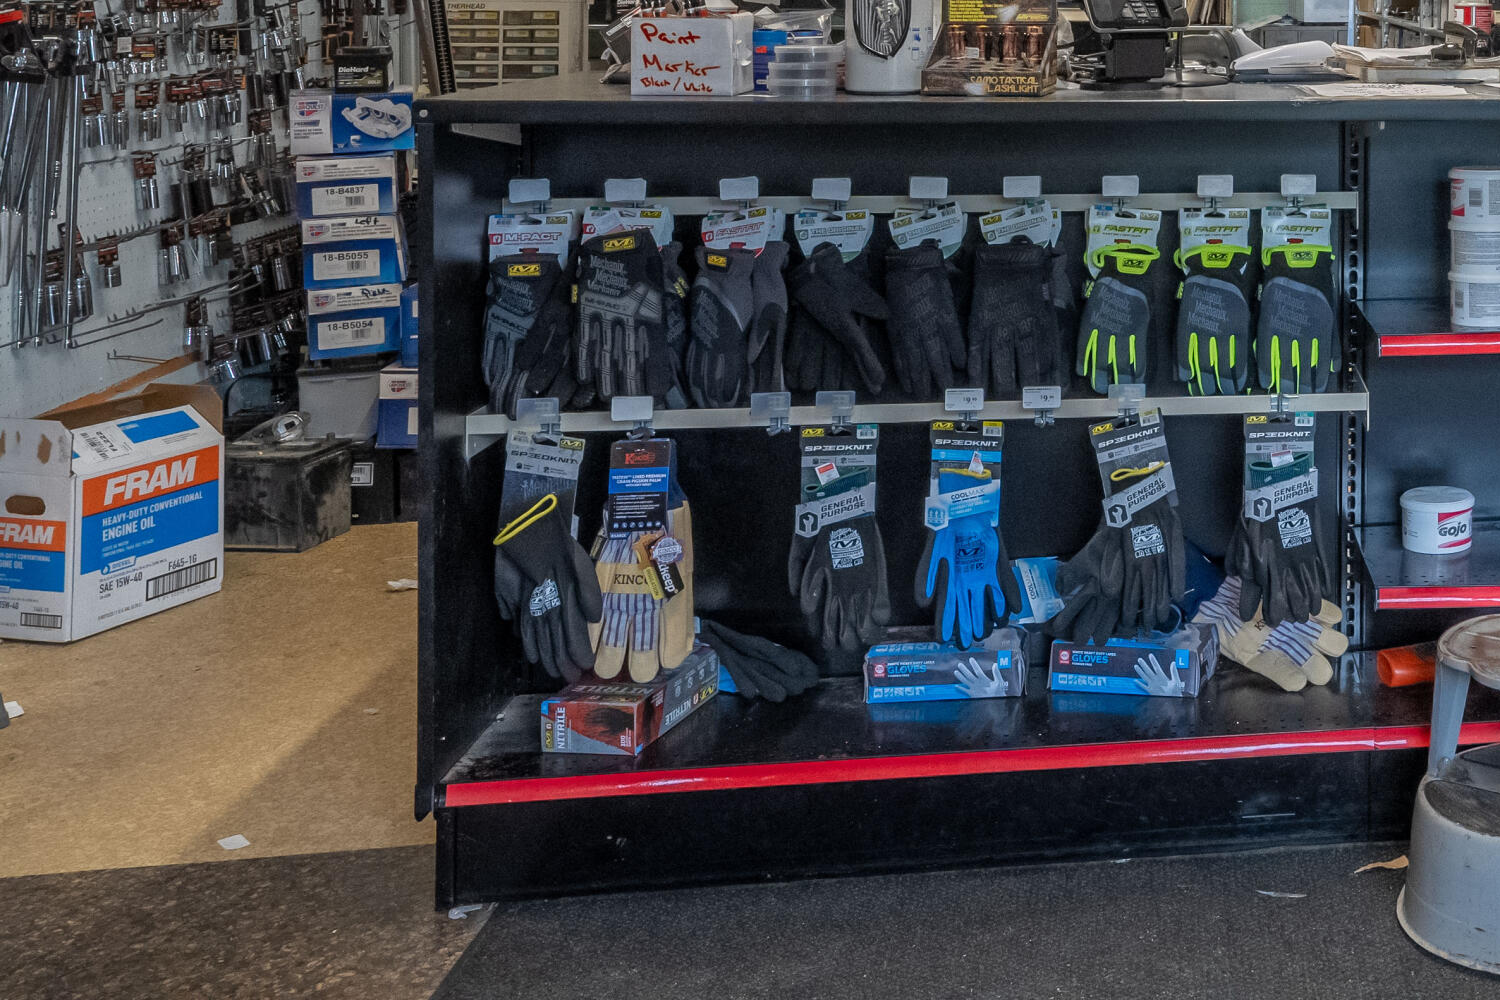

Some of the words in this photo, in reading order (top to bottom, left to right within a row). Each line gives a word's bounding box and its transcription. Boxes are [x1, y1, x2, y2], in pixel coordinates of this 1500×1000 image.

[640, 22, 702, 45] Paint
[642, 53, 721, 77] Marker
[640, 77, 672, 88] Black
[969, 75, 999, 85] CAMO
[999, 76, 1039, 85] TACTICAL
[984, 84, 1040, 93] FLASHLIGHT
[325, 186, 365, 196] 18-B4837
[503, 231, 562, 242] M-PACT
[715, 221, 766, 237] FASTFIT
[1103, 224, 1153, 235] FASTFIT
[1194, 224, 1243, 235] FASTFIT
[322, 252, 369, 262] 18-B5055
[327, 319, 374, 332] 18-B5054
[103, 455, 199, 507] FRAM
[1273, 479, 1311, 498] GENERAL
[950, 487, 986, 501] COOLMAX
[1126, 477, 1164, 504] GENERAL
[1127, 481, 1168, 508] PURPOSE
[1274, 485, 1315, 505] PURPOSE
[102, 505, 149, 527] HEAVY-DUTY
[149, 491, 203, 513] CONVENTIONAL
[821, 495, 864, 514] GENERAL
[821, 500, 866, 520] PURPOSE
[102, 520, 138, 542] ENGINE
[140, 515, 156, 530] OIL
[99, 581, 114, 594] SAE
[115, 571, 143, 589] 15W-40
[999, 656, 1009, 667] M
[1071, 654, 1109, 664] GLOVES
[1178, 657, 1185, 666] L
[887, 664, 927, 675] GLOVES
[665, 698, 692, 726] NITRILE
[557, 707, 566, 749] NITRILE
